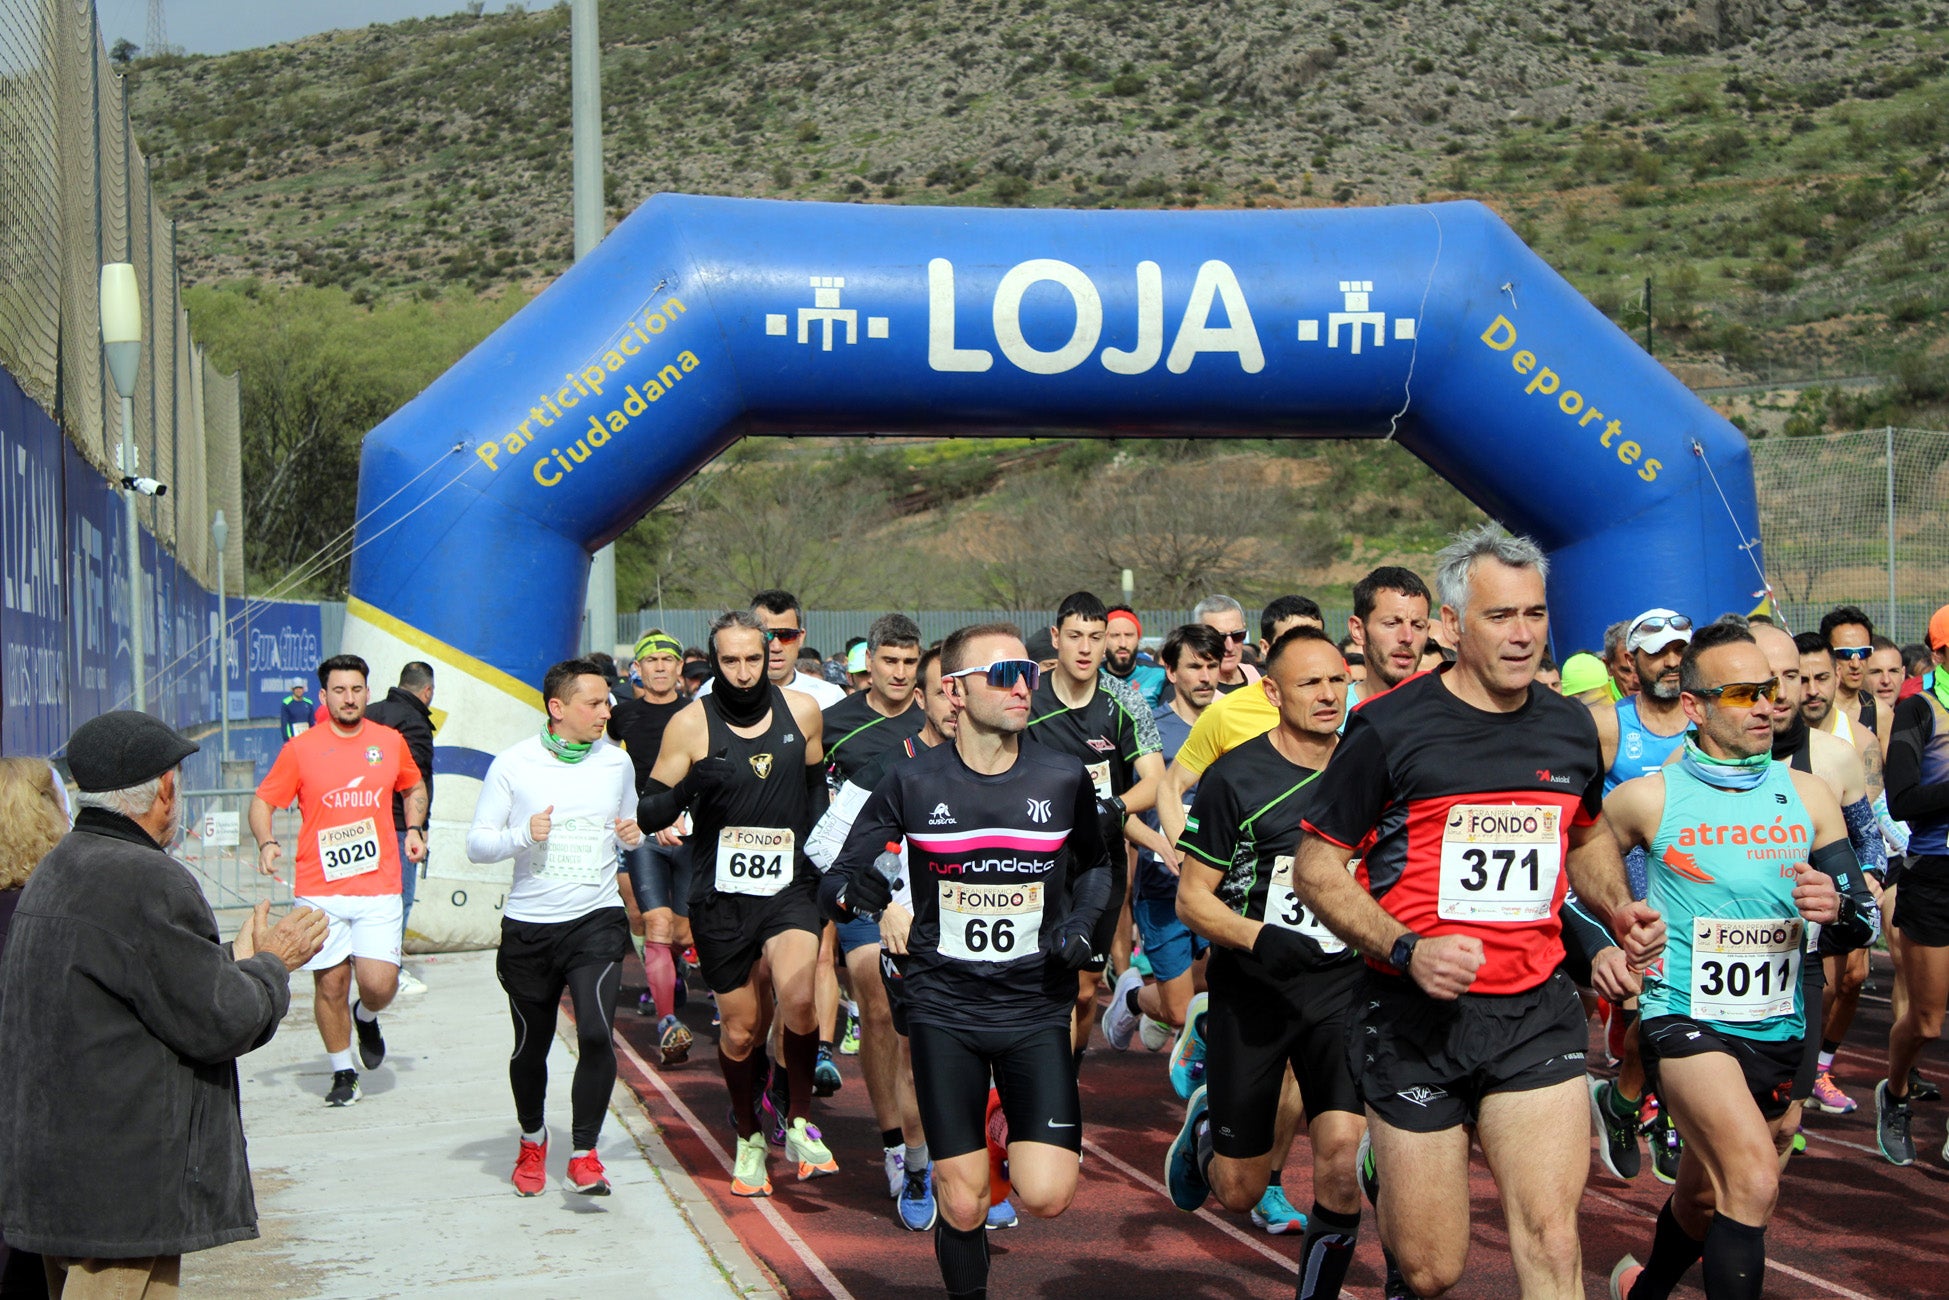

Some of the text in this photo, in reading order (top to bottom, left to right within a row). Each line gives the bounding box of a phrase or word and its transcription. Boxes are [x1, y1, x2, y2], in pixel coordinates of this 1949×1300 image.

[928, 257, 1266, 375] LOJA
[476, 297, 687, 472] Participación
[1480, 313, 1664, 482] Deportes
[533, 350, 700, 487] Ciudadana
[334, 791, 373, 808] APOLO
[330, 826, 365, 841] FONDO
[738, 832, 782, 845] FONDO
[1471, 816, 1538, 834] FONDO
[1678, 815, 1808, 847] atracón
[325, 840, 377, 868] 3020
[729, 852, 782, 879] 684
[929, 857, 1055, 875] runrundata
[1747, 845, 1809, 863] running
[1460, 848, 1539, 892] 371
[1780, 863, 1799, 882] loj
[960, 892, 1024, 908] FONDO
[965, 918, 1015, 953] 66
[1720, 928, 1787, 945] FONDO
[1700, 958, 1790, 997] 3011
